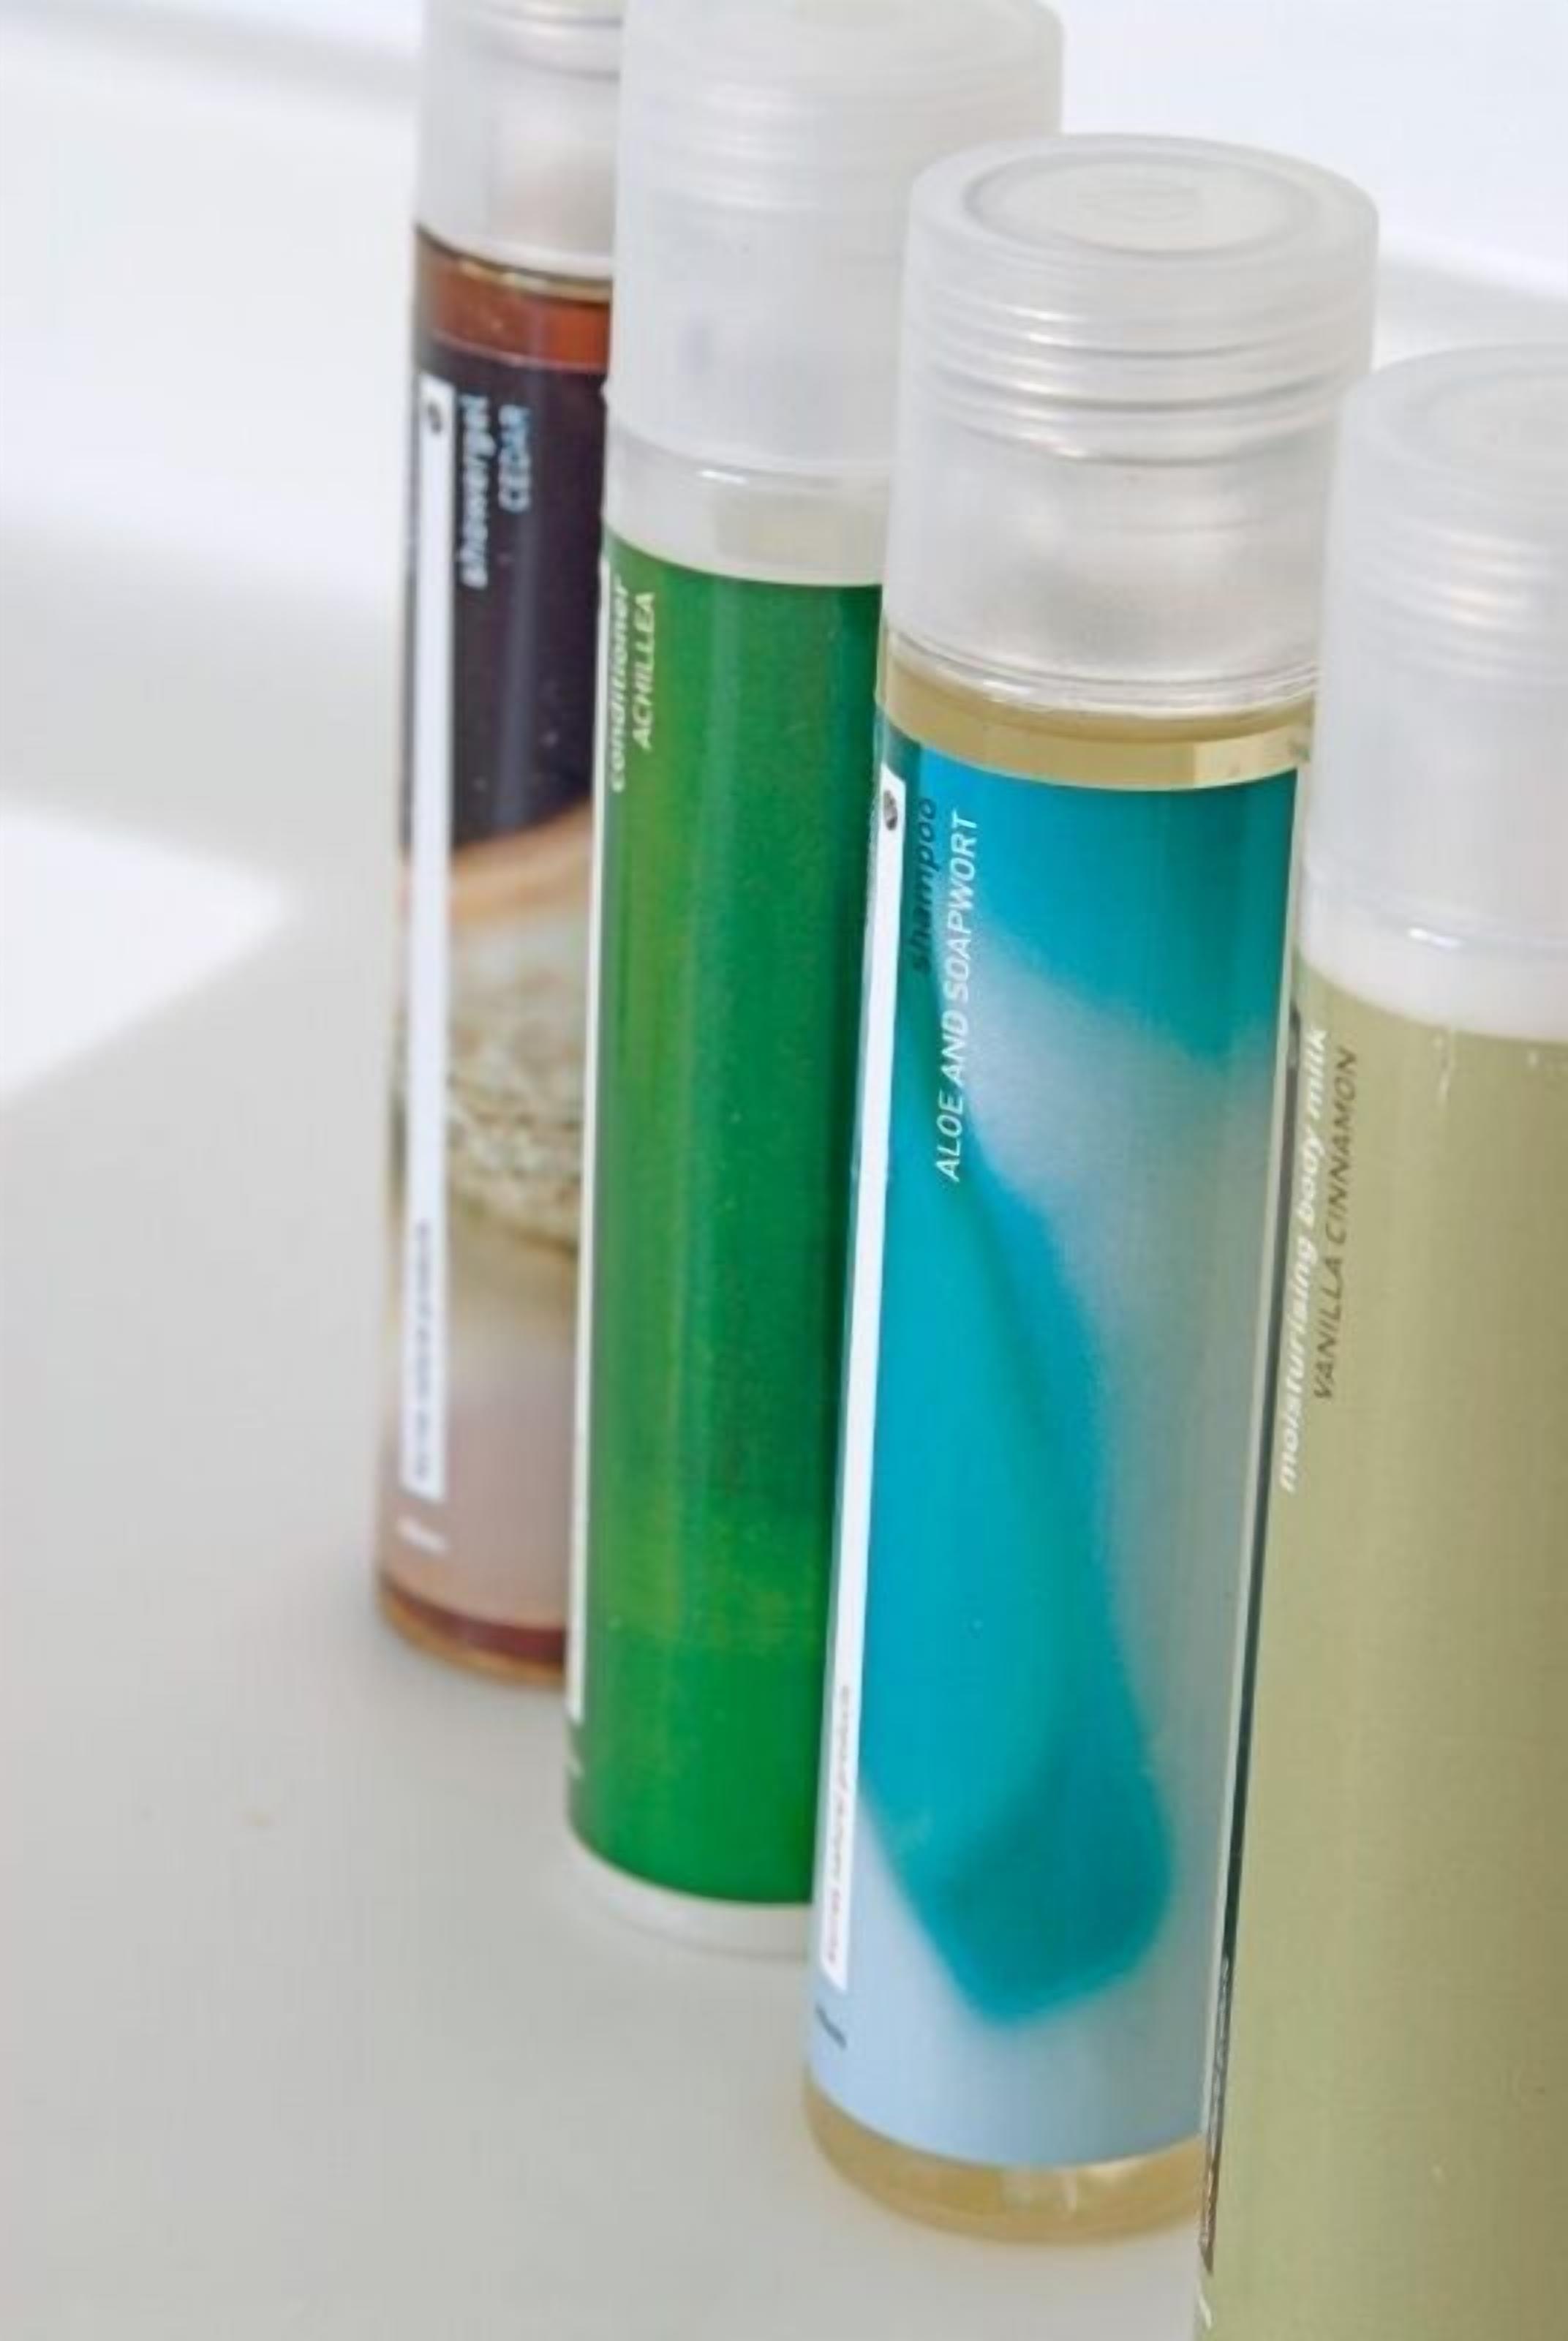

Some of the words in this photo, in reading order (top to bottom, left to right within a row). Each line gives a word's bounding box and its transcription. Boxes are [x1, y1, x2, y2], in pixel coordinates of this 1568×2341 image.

[459, 394, 497, 590] showergel
[497, 404, 532, 514] CEDAR
[611, 574, 629, 793] conditioner
[631, 592, 656, 753] ACHILLEA
[909, 798, 942, 978] shampoo
[942, 806, 979, 1004] SOAPWORT
[941, 1009, 969, 1089] AND
[1305, 1029, 1328, 1121] milk
[935, 1088, 965, 1183] ALOE
[1296, 1124, 1327, 1230] body
[1324, 1046, 1357, 1246] CINNAMON
[1279, 1233, 1319, 1494] moisturising
[1313, 1256, 1344, 1400] VANILLA
